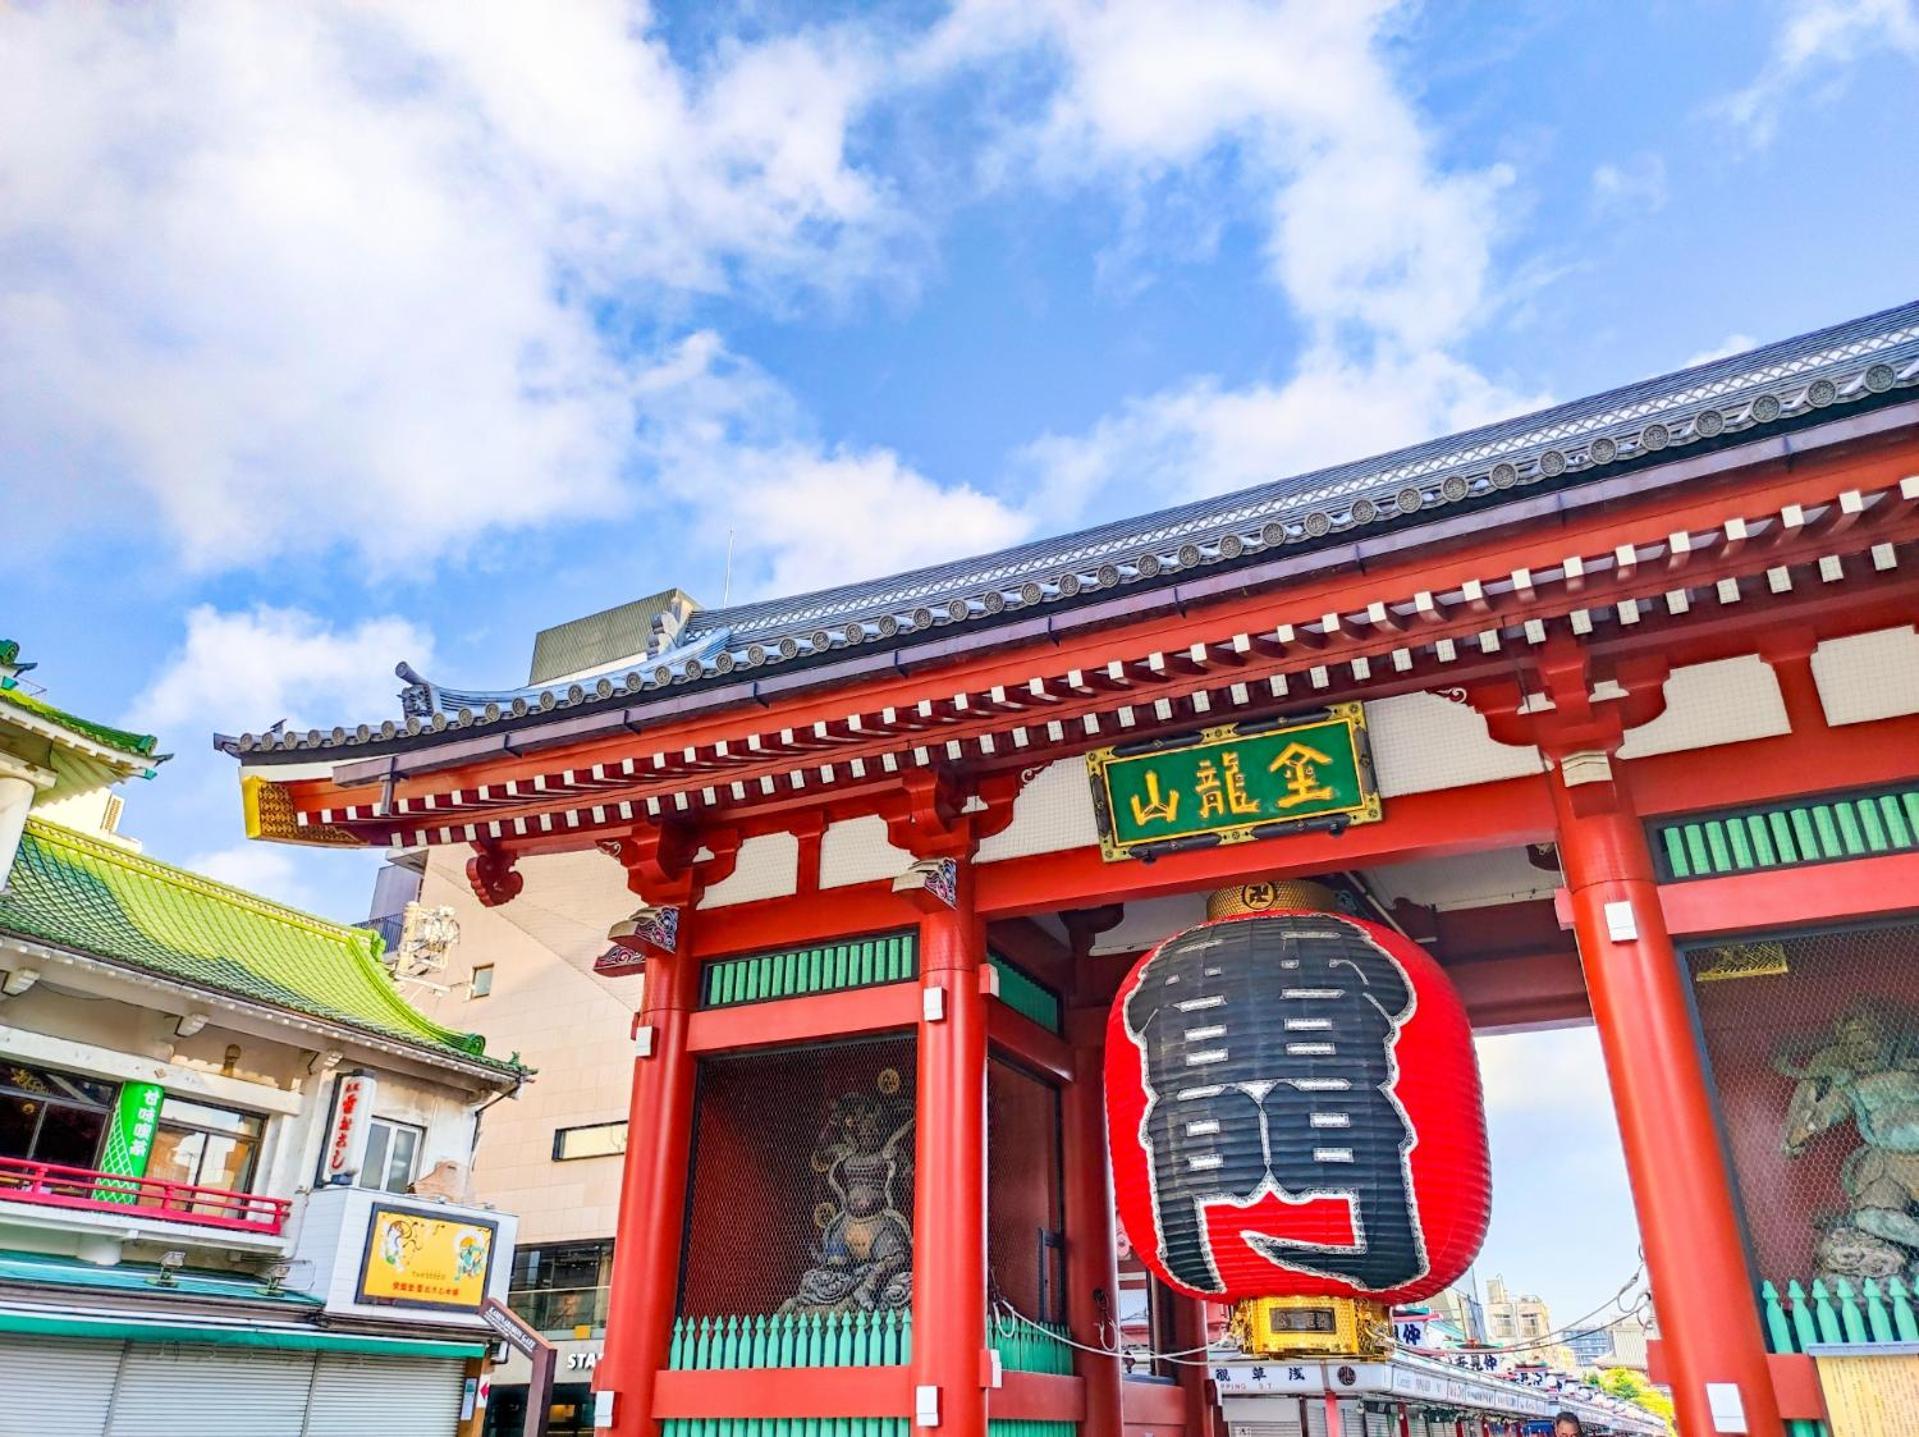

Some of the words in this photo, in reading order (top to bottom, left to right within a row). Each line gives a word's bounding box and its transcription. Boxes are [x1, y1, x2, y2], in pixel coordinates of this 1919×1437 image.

[129, 1089, 160, 1157] 甘味喫茶
[1122, 913, 1431, 1293] 雷門
